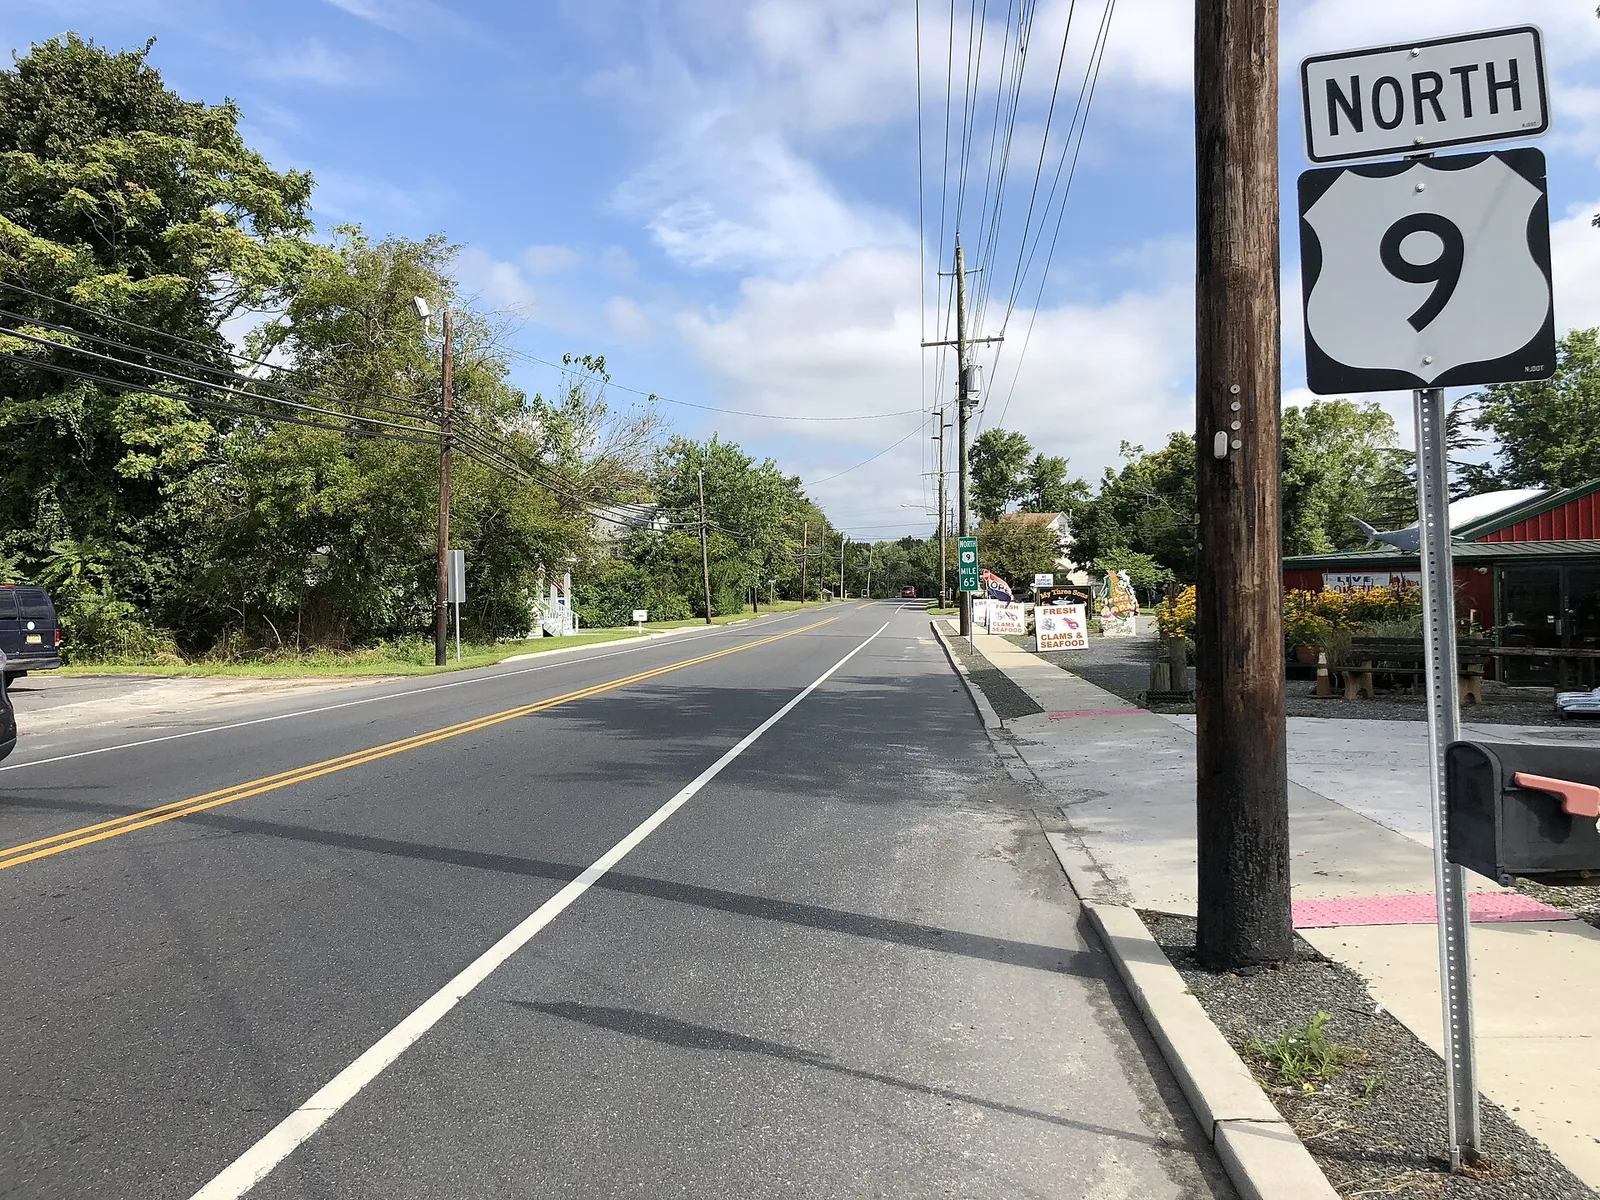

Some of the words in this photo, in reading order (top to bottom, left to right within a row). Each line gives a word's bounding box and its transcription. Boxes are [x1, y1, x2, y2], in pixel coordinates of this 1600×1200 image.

[1326, 58, 1522, 136] NORTH
[1379, 212, 1465, 333] 9
[960, 540, 977, 548] NORTH
[963, 577, 975, 587] 65
[990, 581, 1010, 593] OPE
[1039, 591, 1051, 599] My
[1072, 589, 1089, 600] Sons
[1042, 607, 1077, 616] FRESH
[1040, 632, 1074, 641] CLAMS
[1075, 631, 1083, 639] &
[1040, 639, 1085, 649] SEAFOOD
